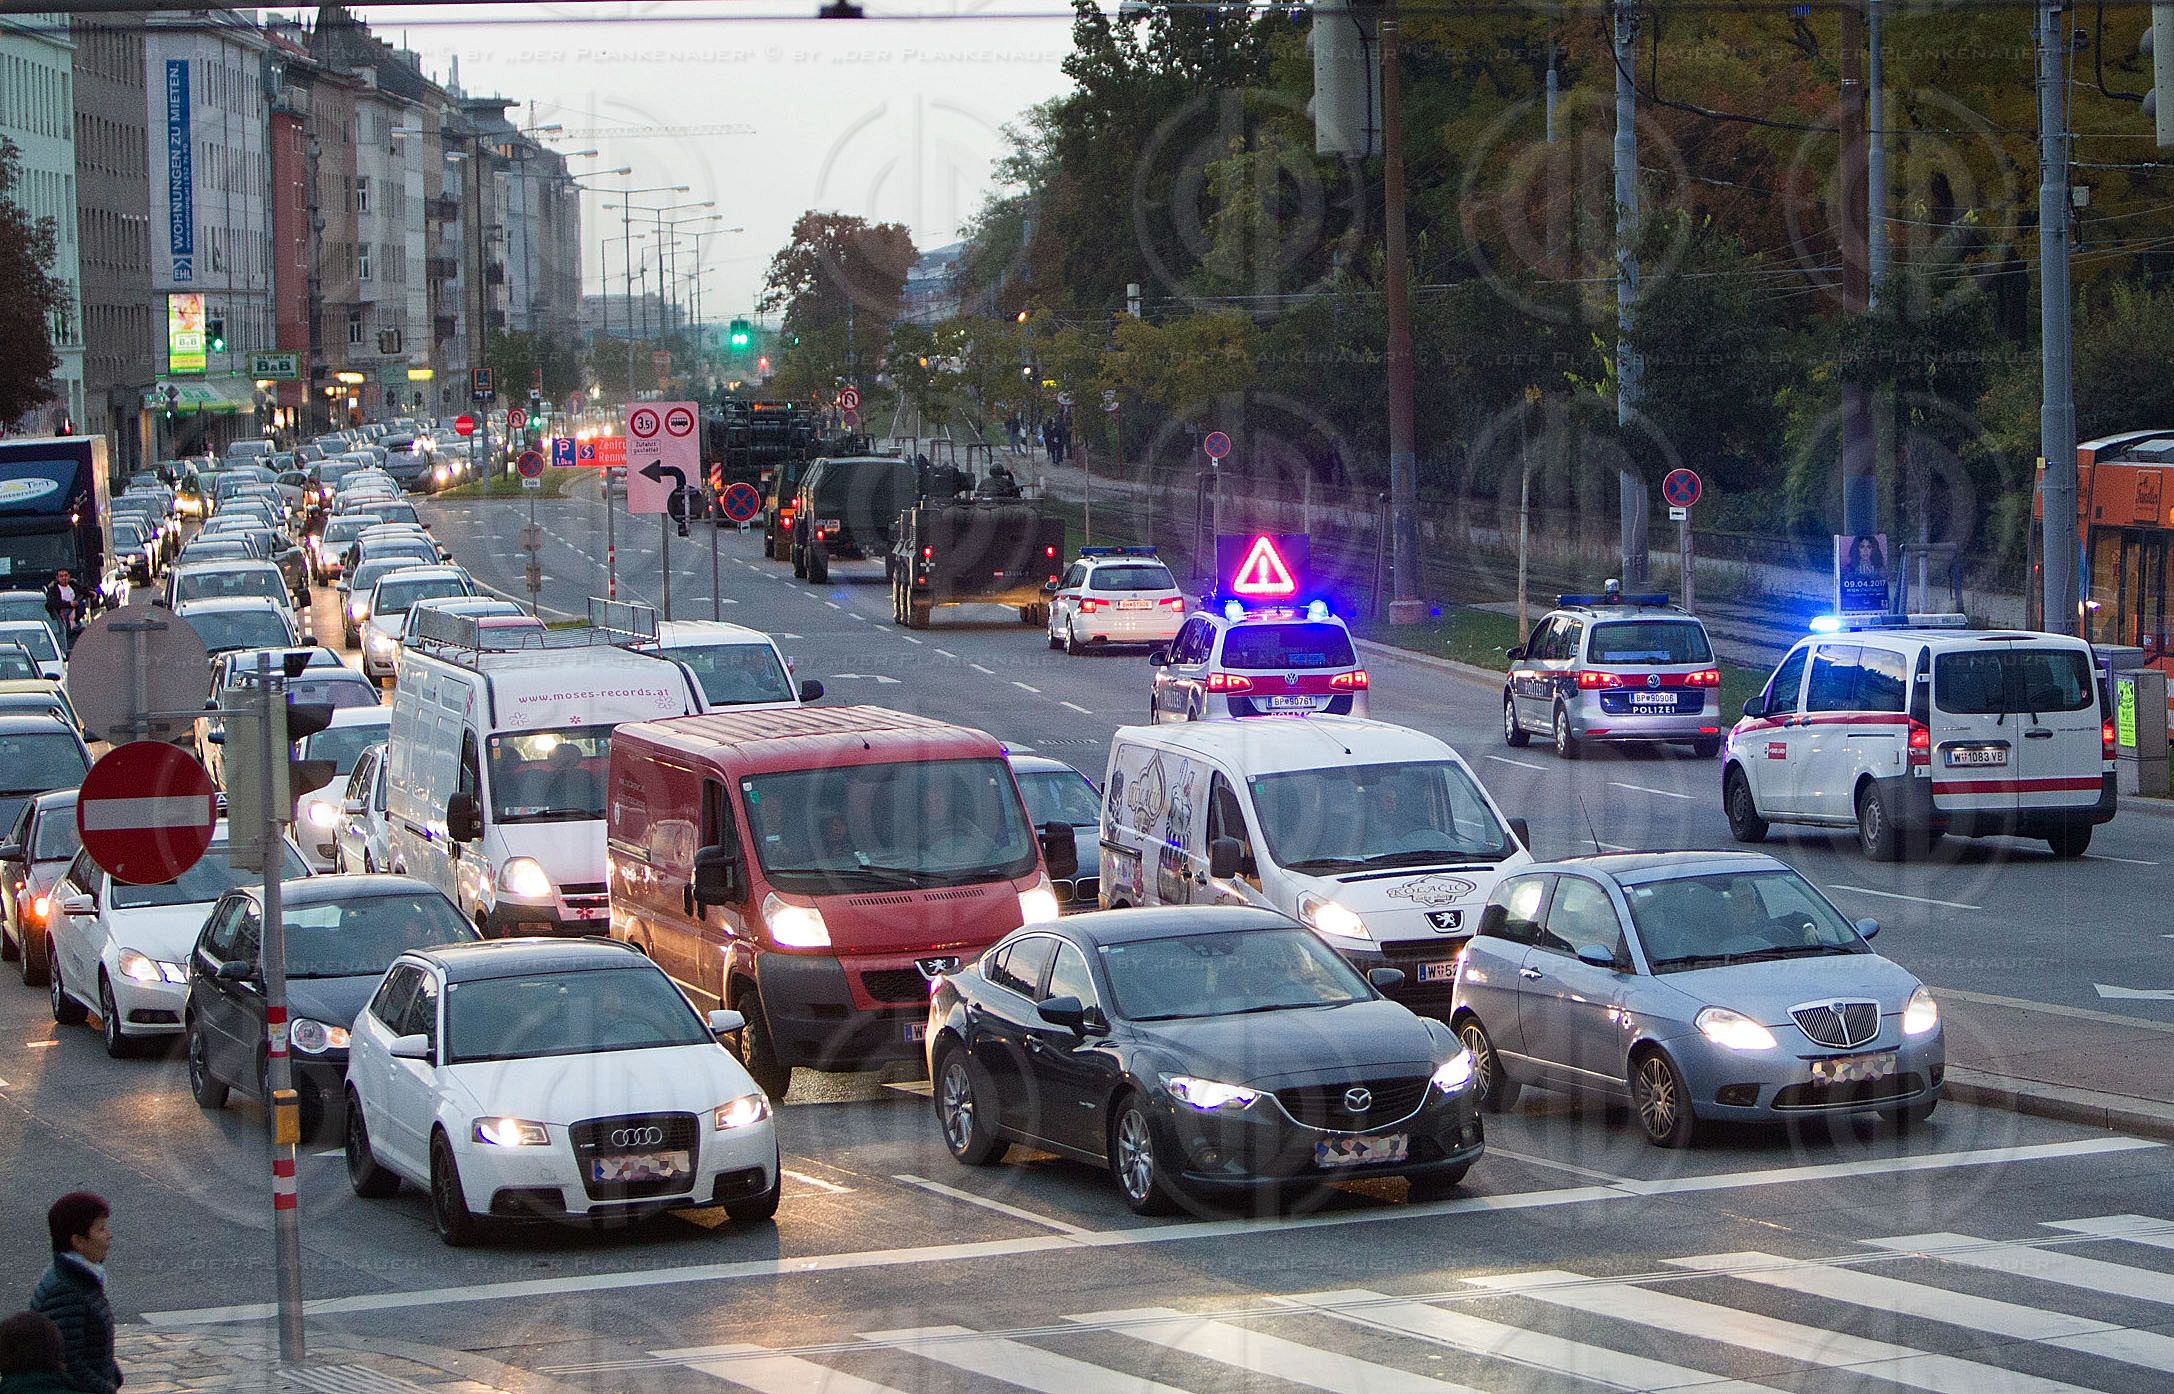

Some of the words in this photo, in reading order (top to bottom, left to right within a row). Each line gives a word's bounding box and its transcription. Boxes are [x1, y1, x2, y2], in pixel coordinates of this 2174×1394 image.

[169, 63, 181, 121] MIETEN.
[171, 126, 181, 145] ZU
[171, 150, 184, 249] WOHNUNGEN
[174, 269, 192, 280] EHL
[257, 361, 291, 371] B&B
[559, 443, 569, 456] P
[599, 439, 626, 450] Zentru
[599, 452, 627, 463] Rennw
[525, 479, 538, 487] Ende
[1844, 579, 1886, 588] 09.04.2017
[518, 687, 669, 704] www.moses-records.at
[1633, 706, 1675, 714] POLIZEI
